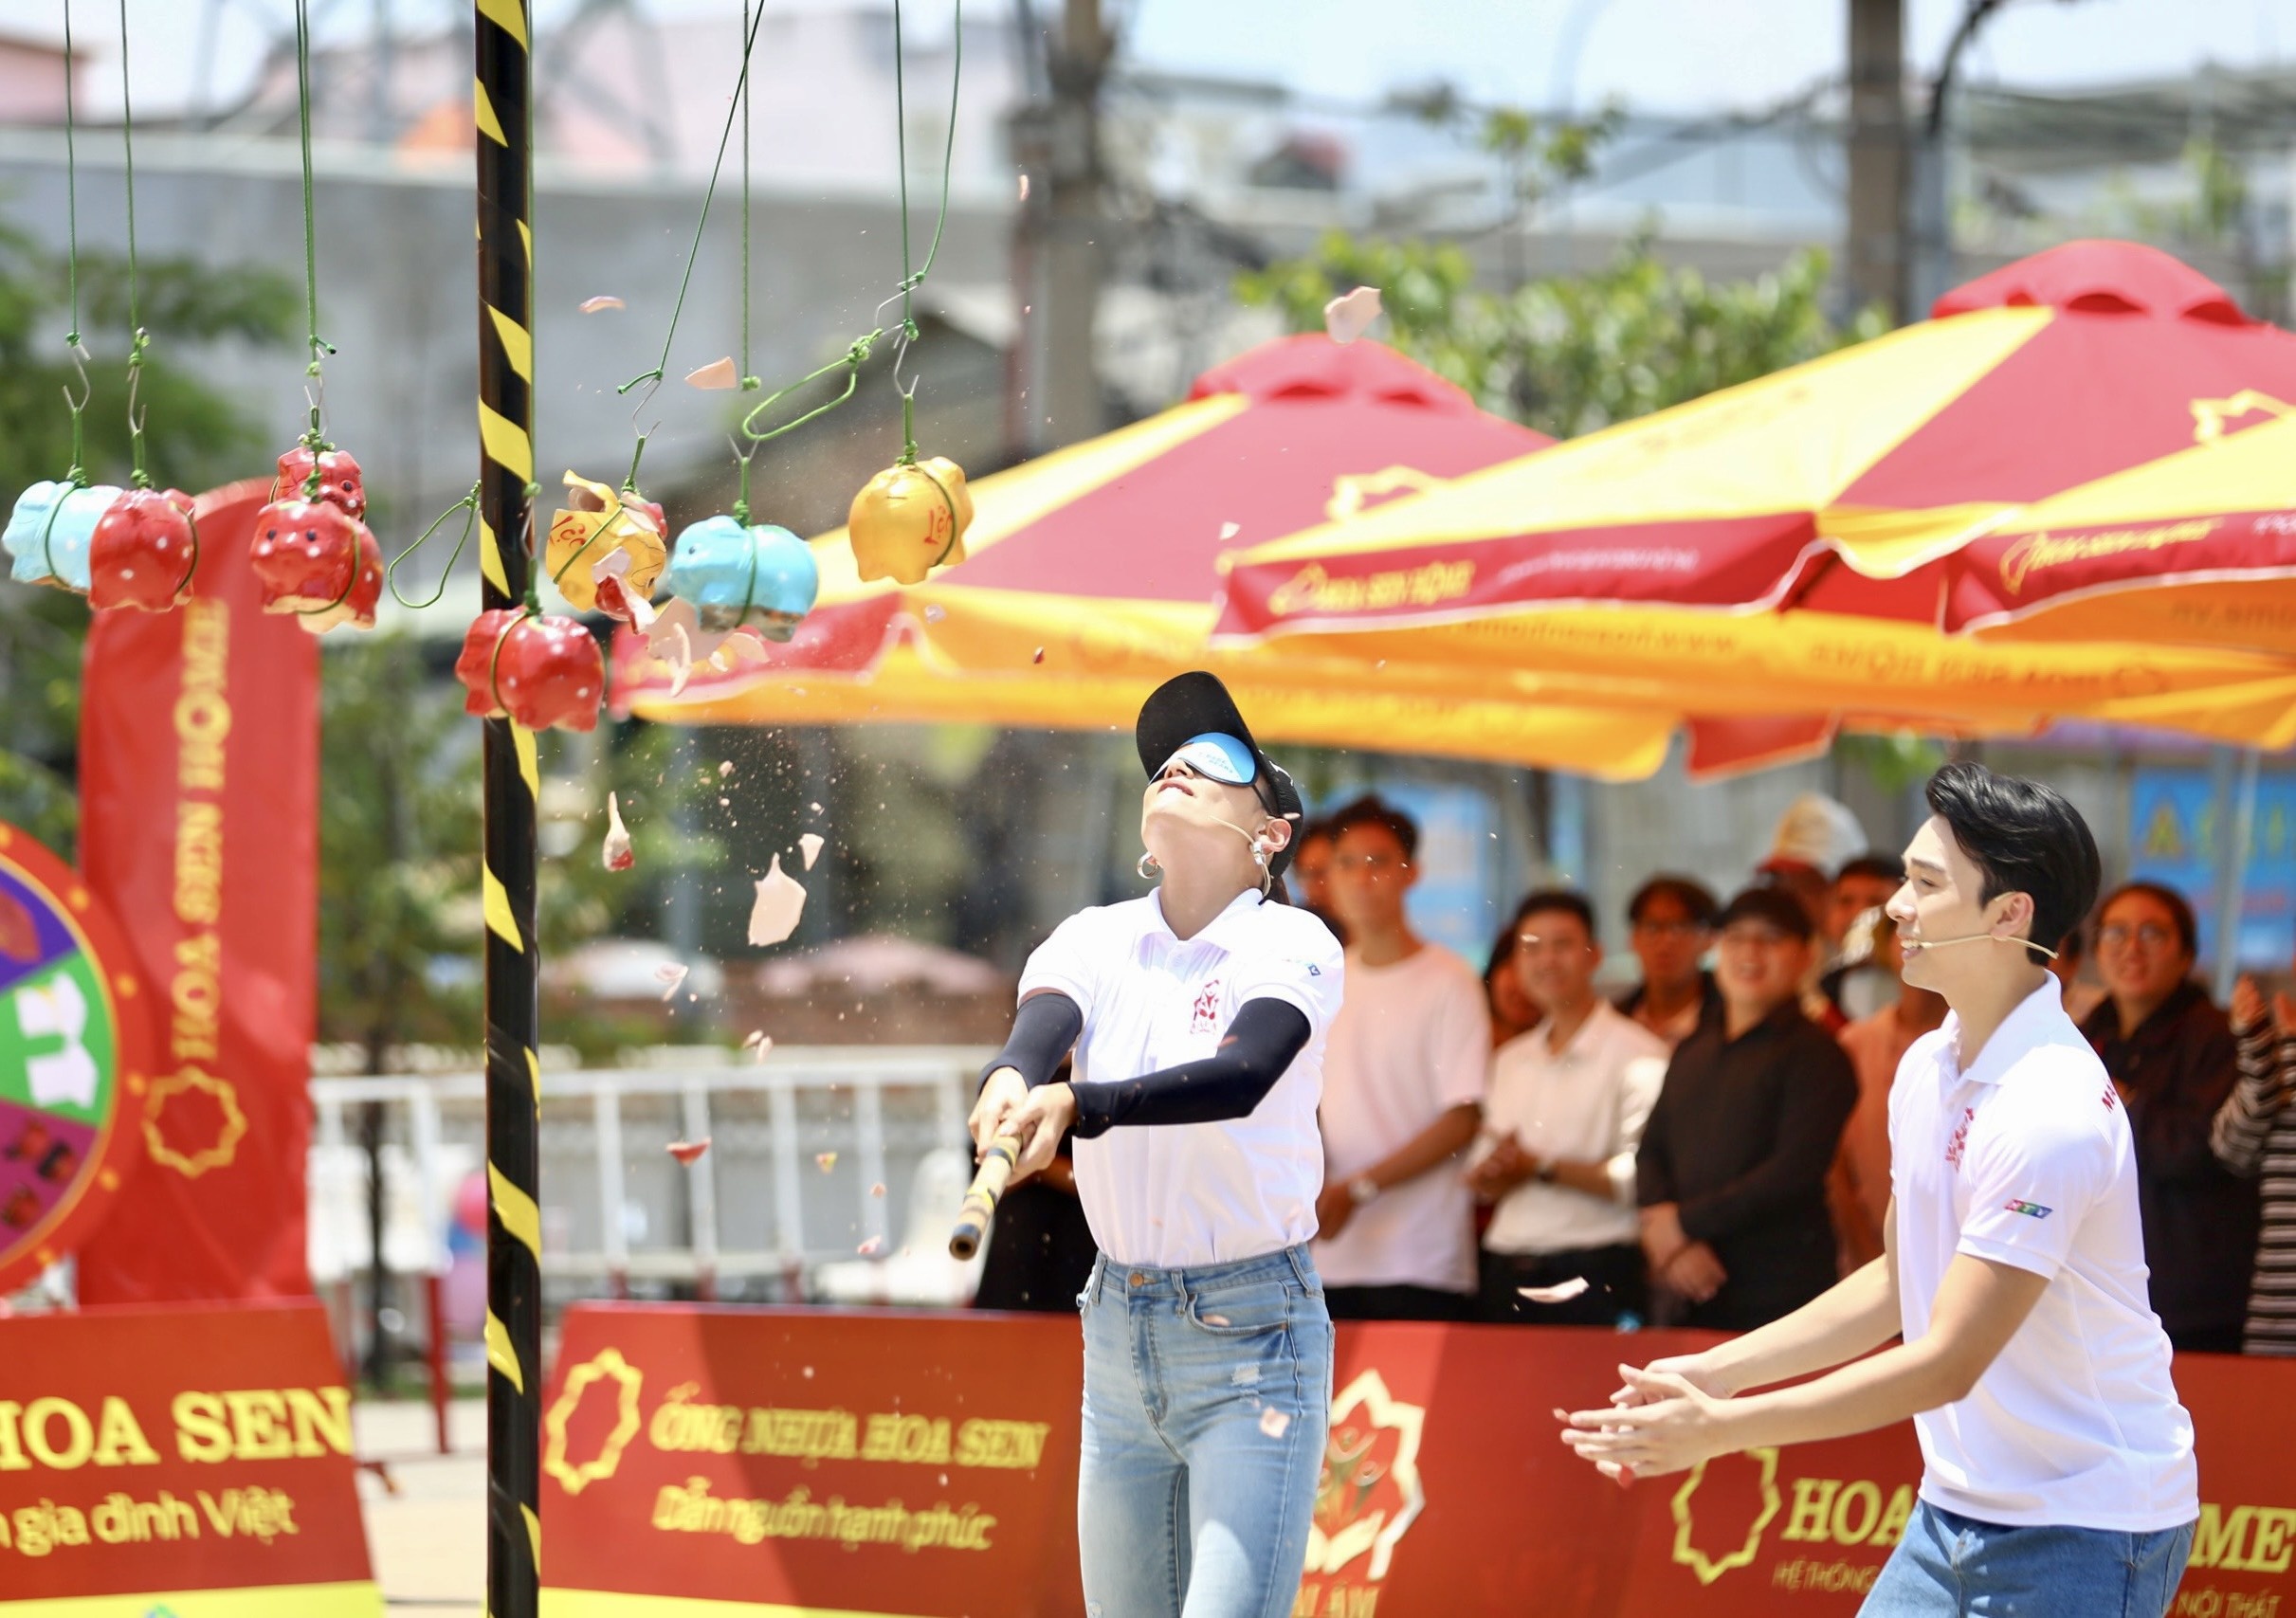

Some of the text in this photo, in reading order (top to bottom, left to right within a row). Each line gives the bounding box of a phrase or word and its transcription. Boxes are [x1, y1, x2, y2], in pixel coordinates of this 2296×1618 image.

[171, 1385, 354, 1464] SEN
[13, 1497, 92, 1557] gia
[91, 1490, 201, 1544] đình
[196, 1484, 300, 1546] Việt
[1780, 1478, 1914, 1546] HOA
